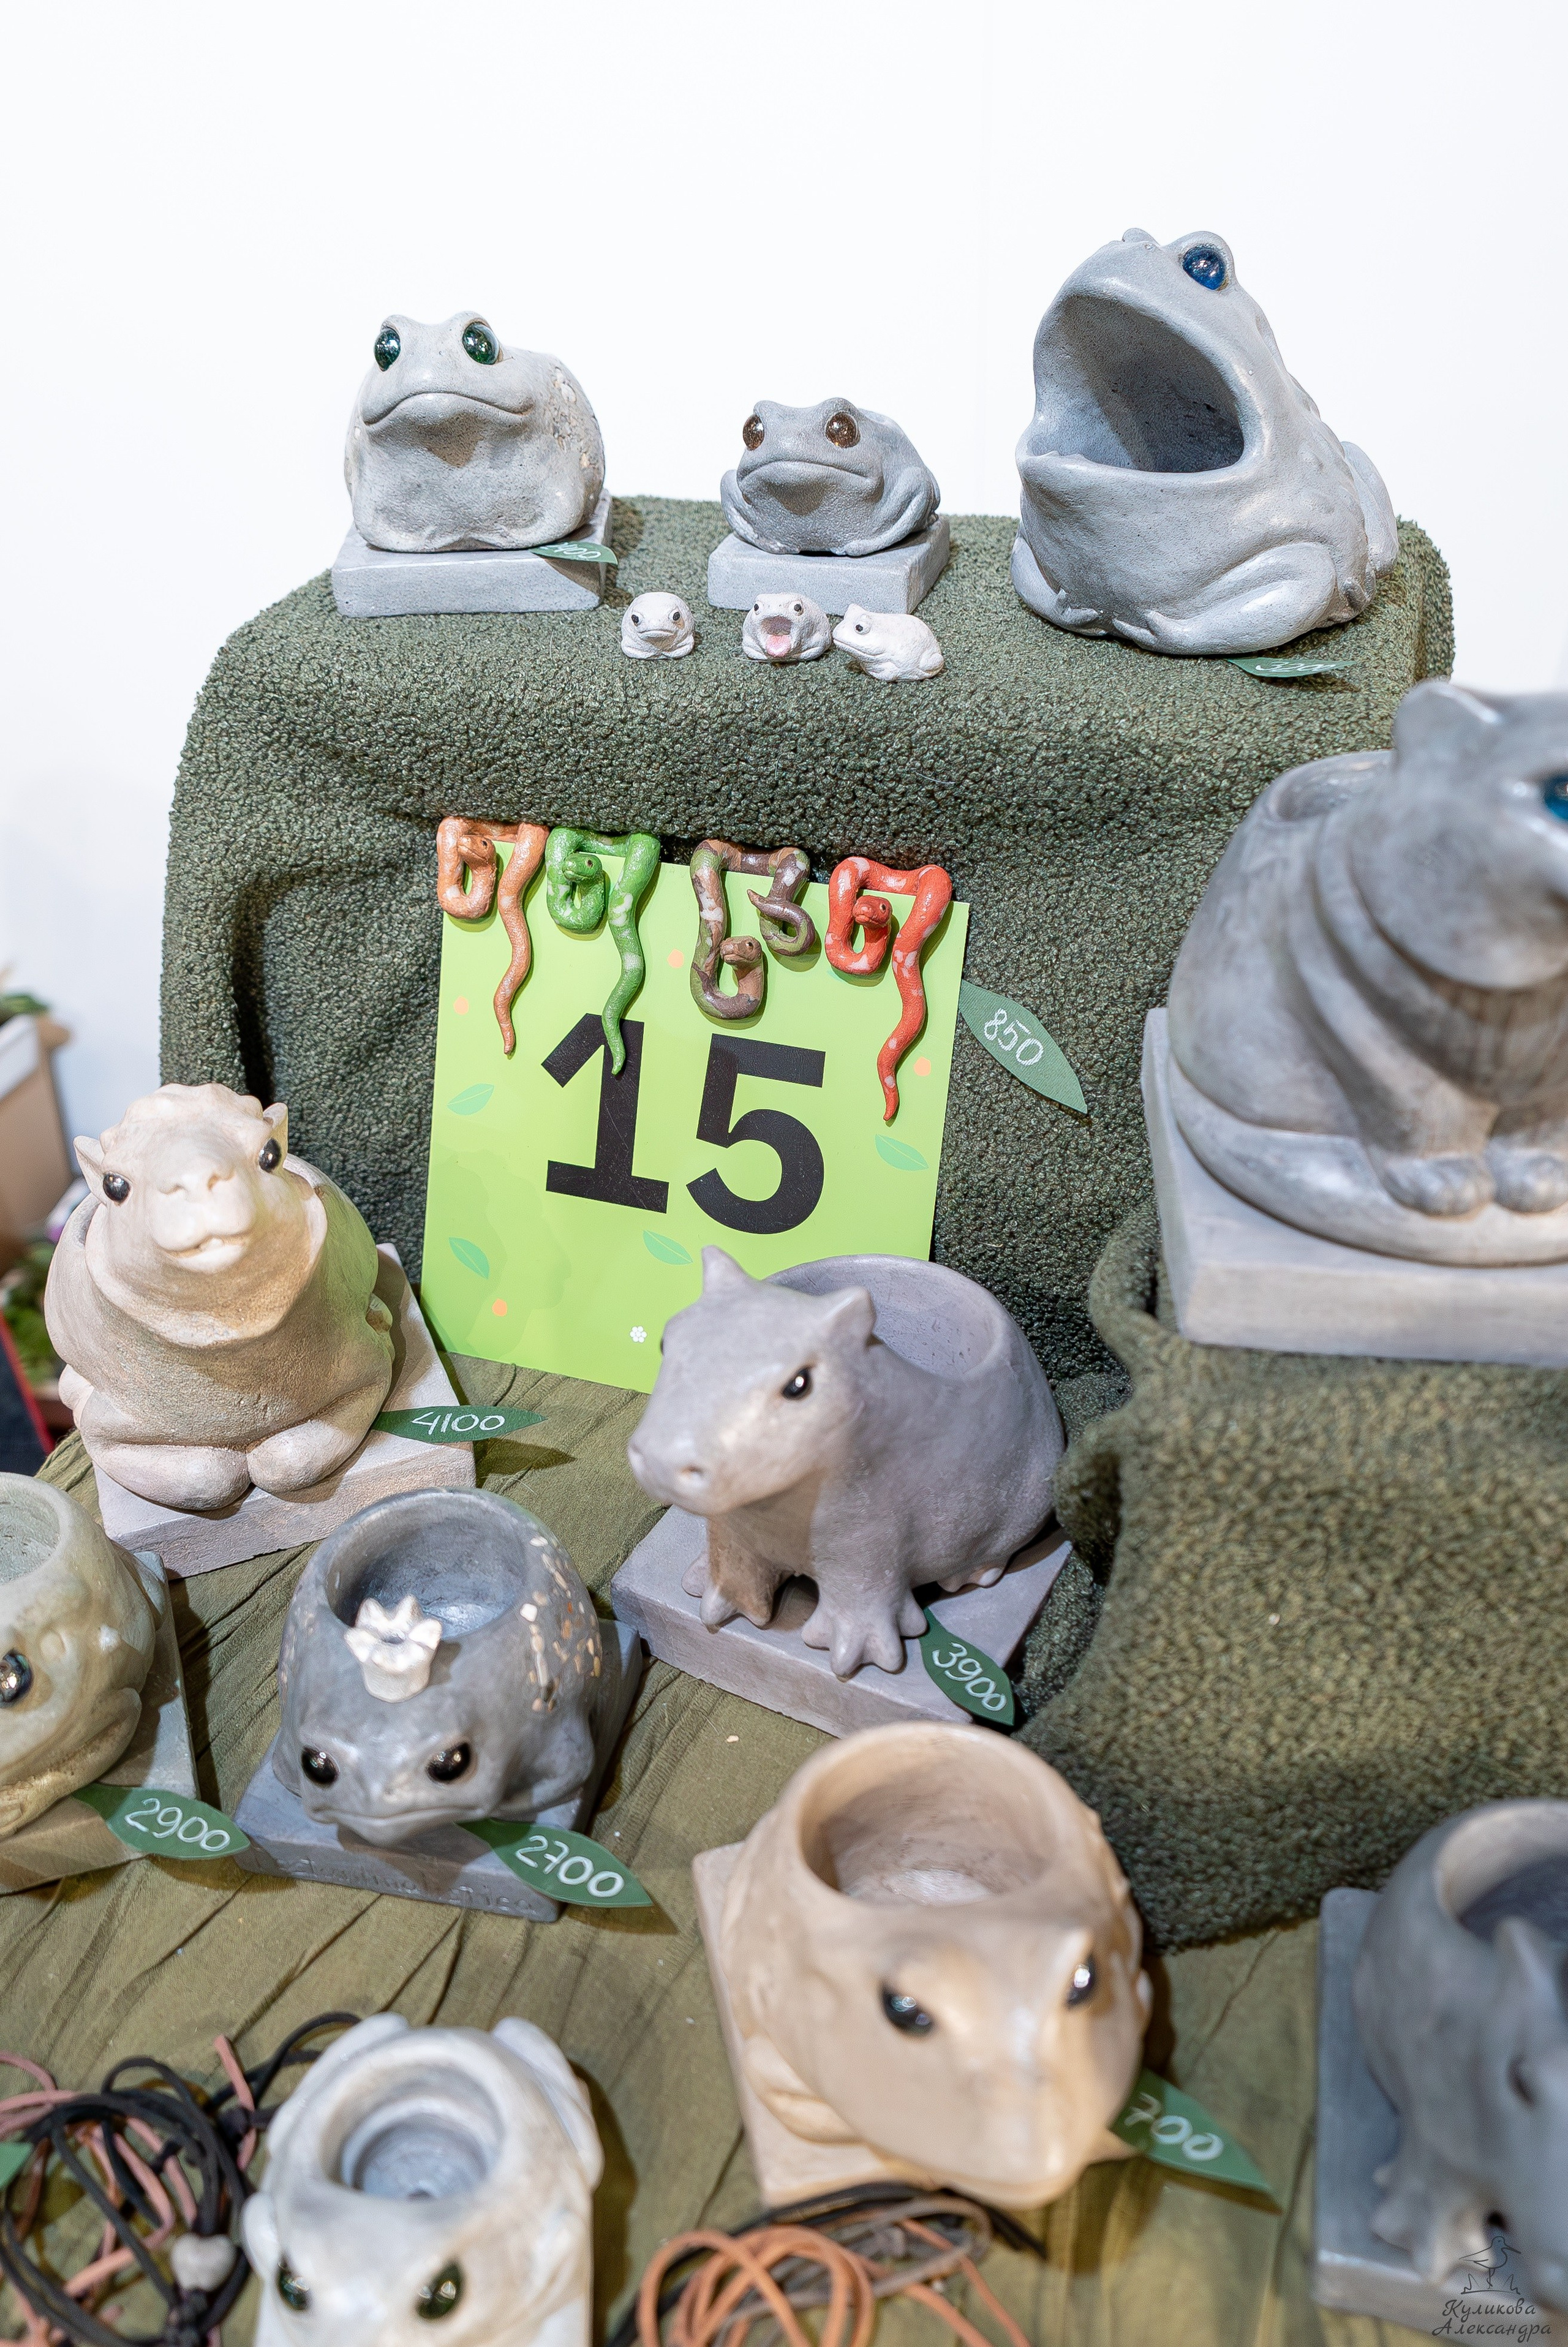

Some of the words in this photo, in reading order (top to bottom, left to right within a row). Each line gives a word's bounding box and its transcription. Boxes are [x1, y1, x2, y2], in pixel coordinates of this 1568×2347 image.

[984, 1008, 1044, 1066] 850
[541, 1013, 826, 1234] 15
[411, 1412, 505, 1435] 4100
[932, 1642, 1006, 1711] 3900
[124, 1798, 230, 1852] 2900
[516, 1835, 624, 1897] 2700
